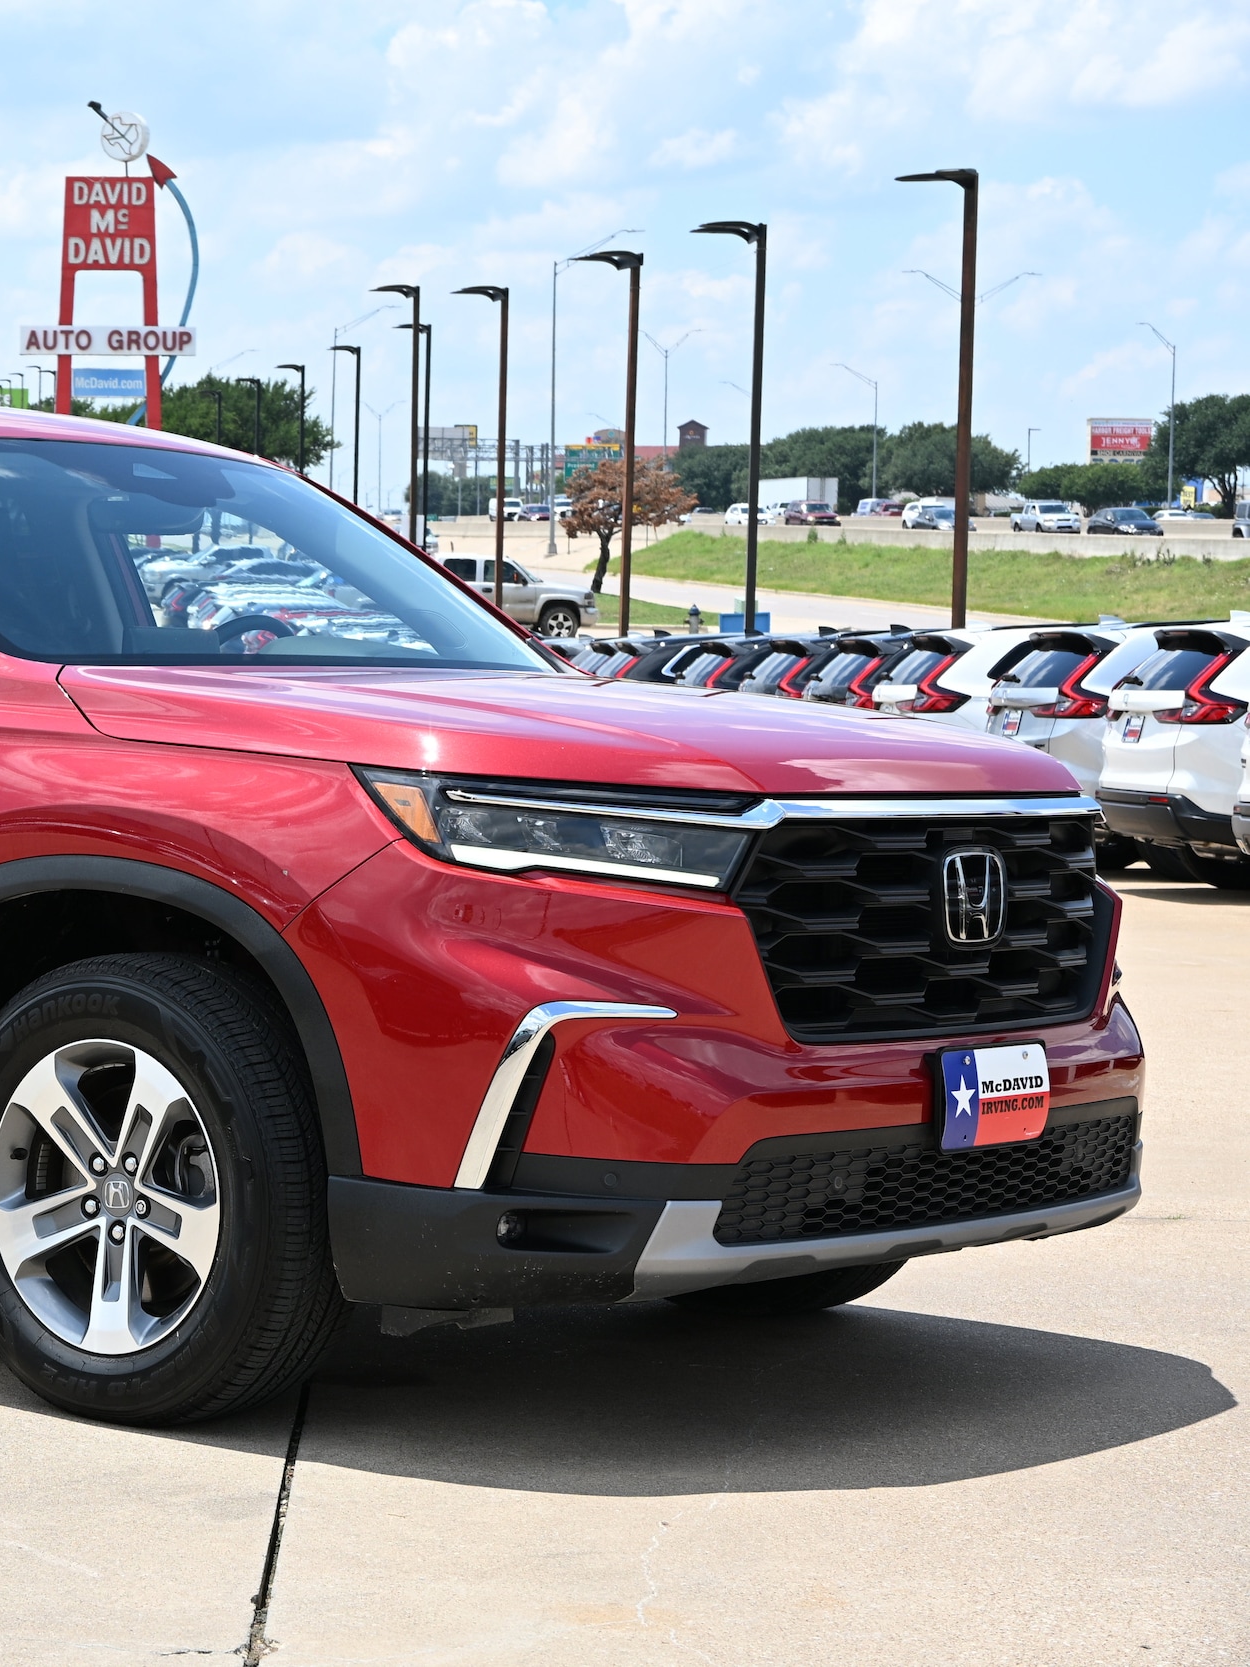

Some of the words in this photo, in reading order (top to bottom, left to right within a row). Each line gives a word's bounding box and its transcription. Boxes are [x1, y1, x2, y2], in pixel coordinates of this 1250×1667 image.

[73, 181, 147, 206] DAVID
[90, 208, 129, 234] Mc
[68, 236, 152, 265] DAVID
[25, 330, 92, 351] AUTO
[107, 330, 192, 352] GROUP
[74, 376, 143, 390] McDavid.com
[981, 1075, 1044, 1094] McDAVID
[981, 1095, 1045, 1115] IRVING.COM
